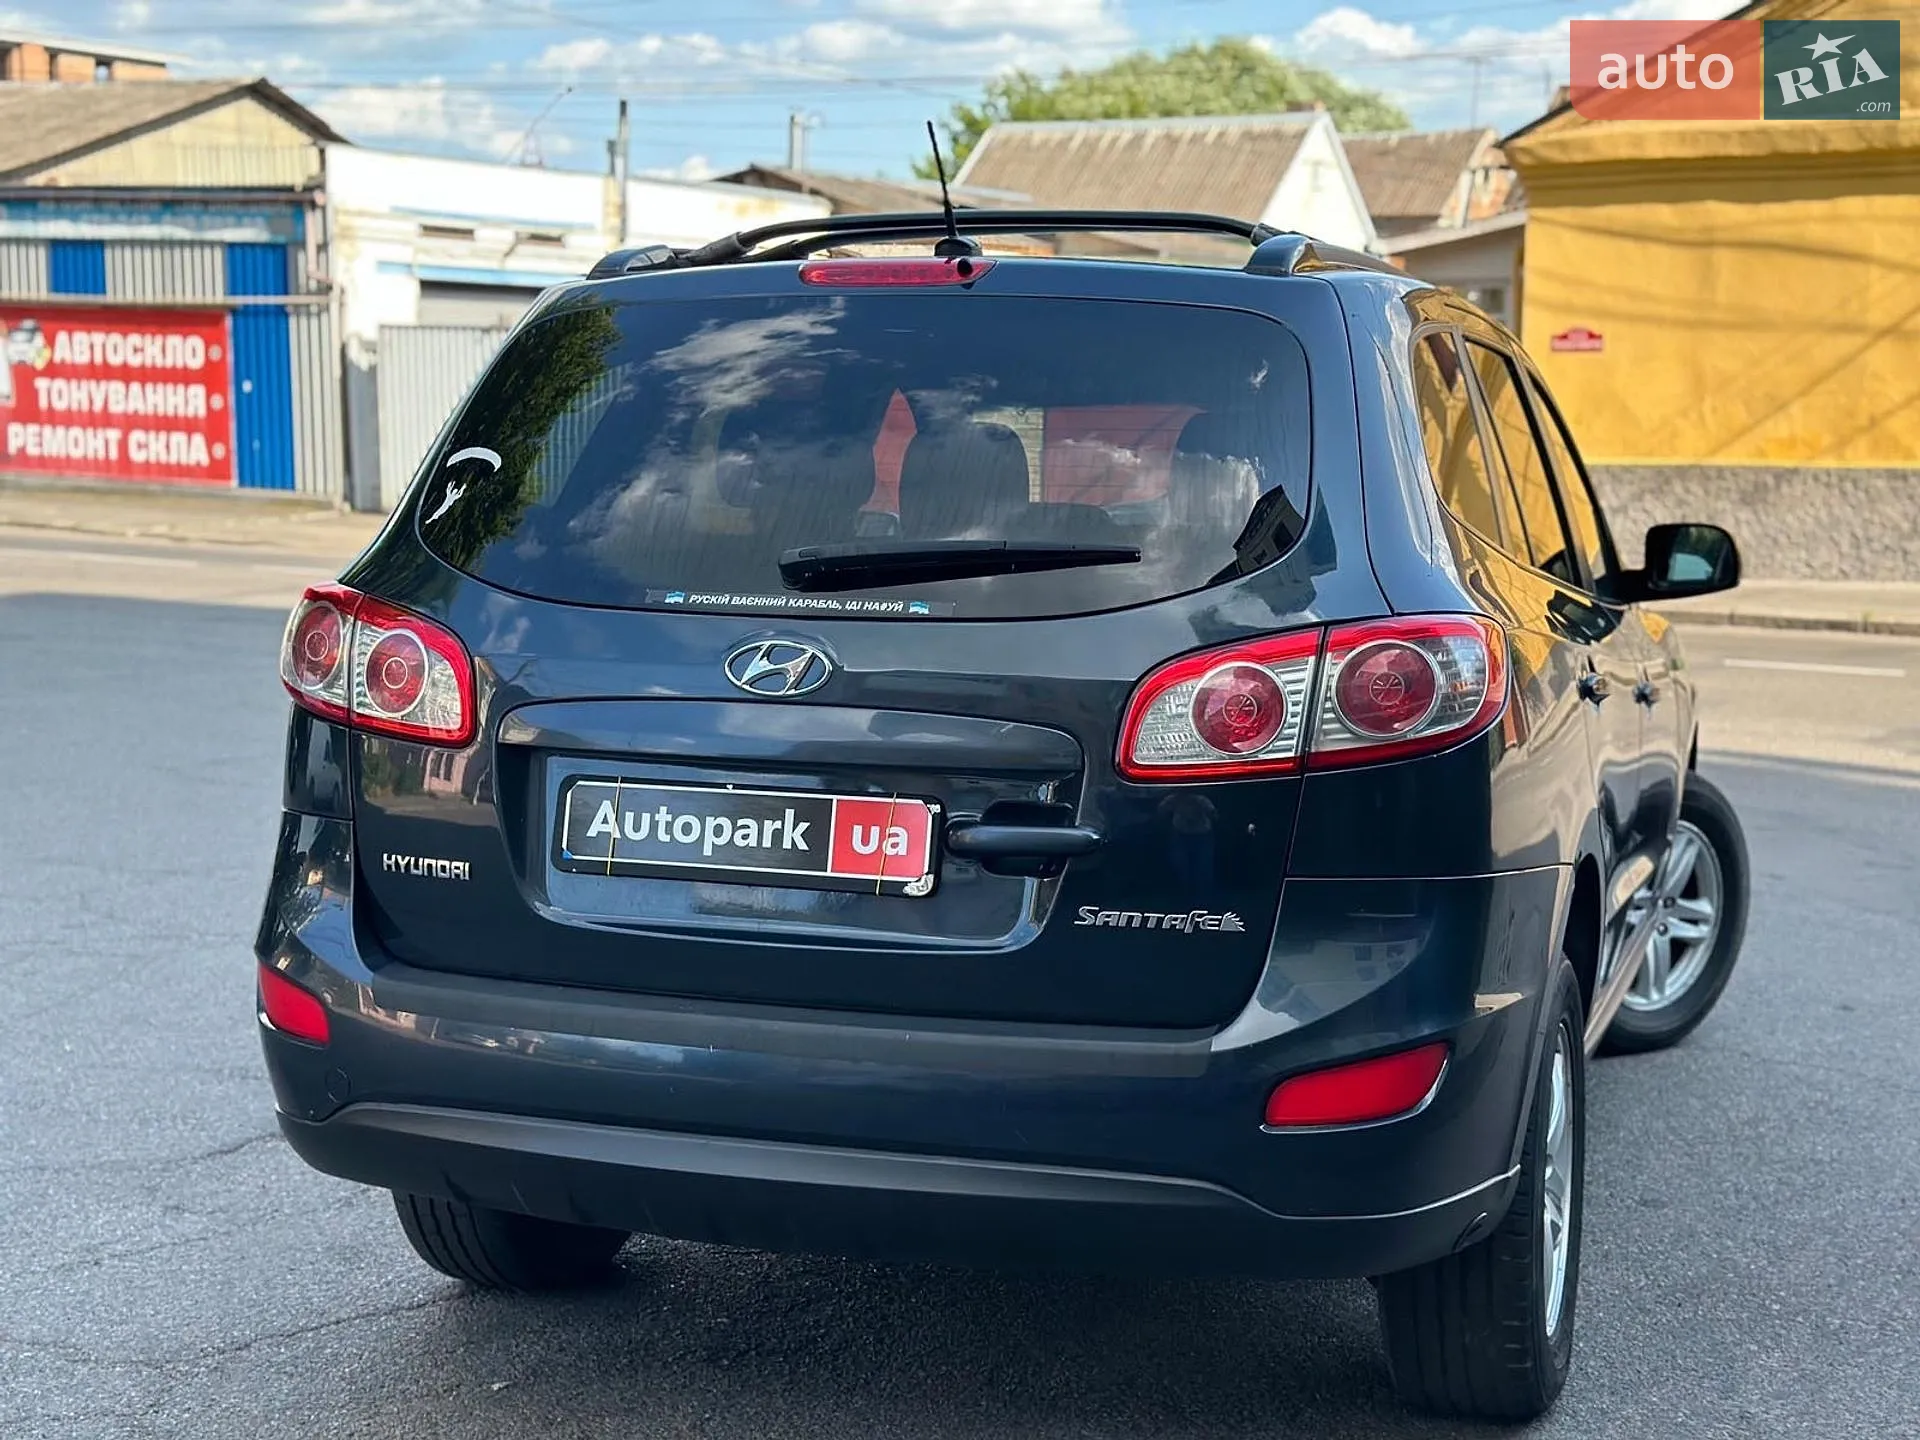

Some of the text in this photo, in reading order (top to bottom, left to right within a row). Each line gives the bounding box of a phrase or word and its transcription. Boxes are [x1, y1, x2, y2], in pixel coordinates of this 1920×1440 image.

[53, 329, 206, 370] АВТОСКЛО
[34, 376, 208, 419] ТОНУВАННЯ
[7, 421, 210, 467] РЕМОНТ СКЛА
[586, 799, 909, 857] Autopark ua
[382, 853, 470, 881] HYUNDAI
